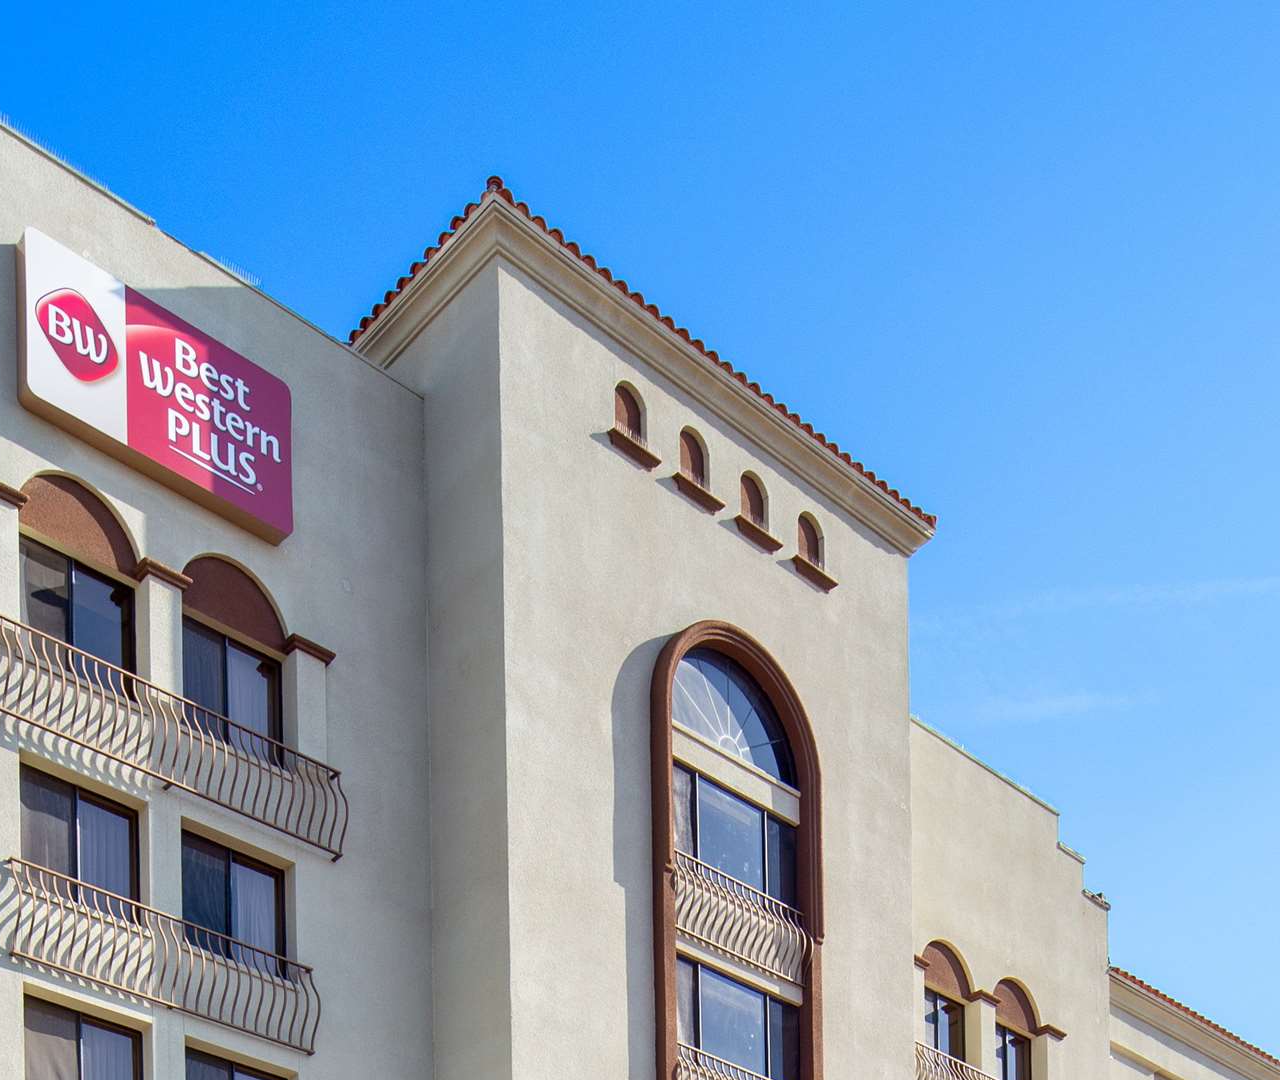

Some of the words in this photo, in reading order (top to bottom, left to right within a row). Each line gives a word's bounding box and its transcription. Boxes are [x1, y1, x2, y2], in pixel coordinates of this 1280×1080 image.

[48, 303, 108, 364] BW
[139, 350, 282, 463] Western
[175, 337, 251, 411] Best
